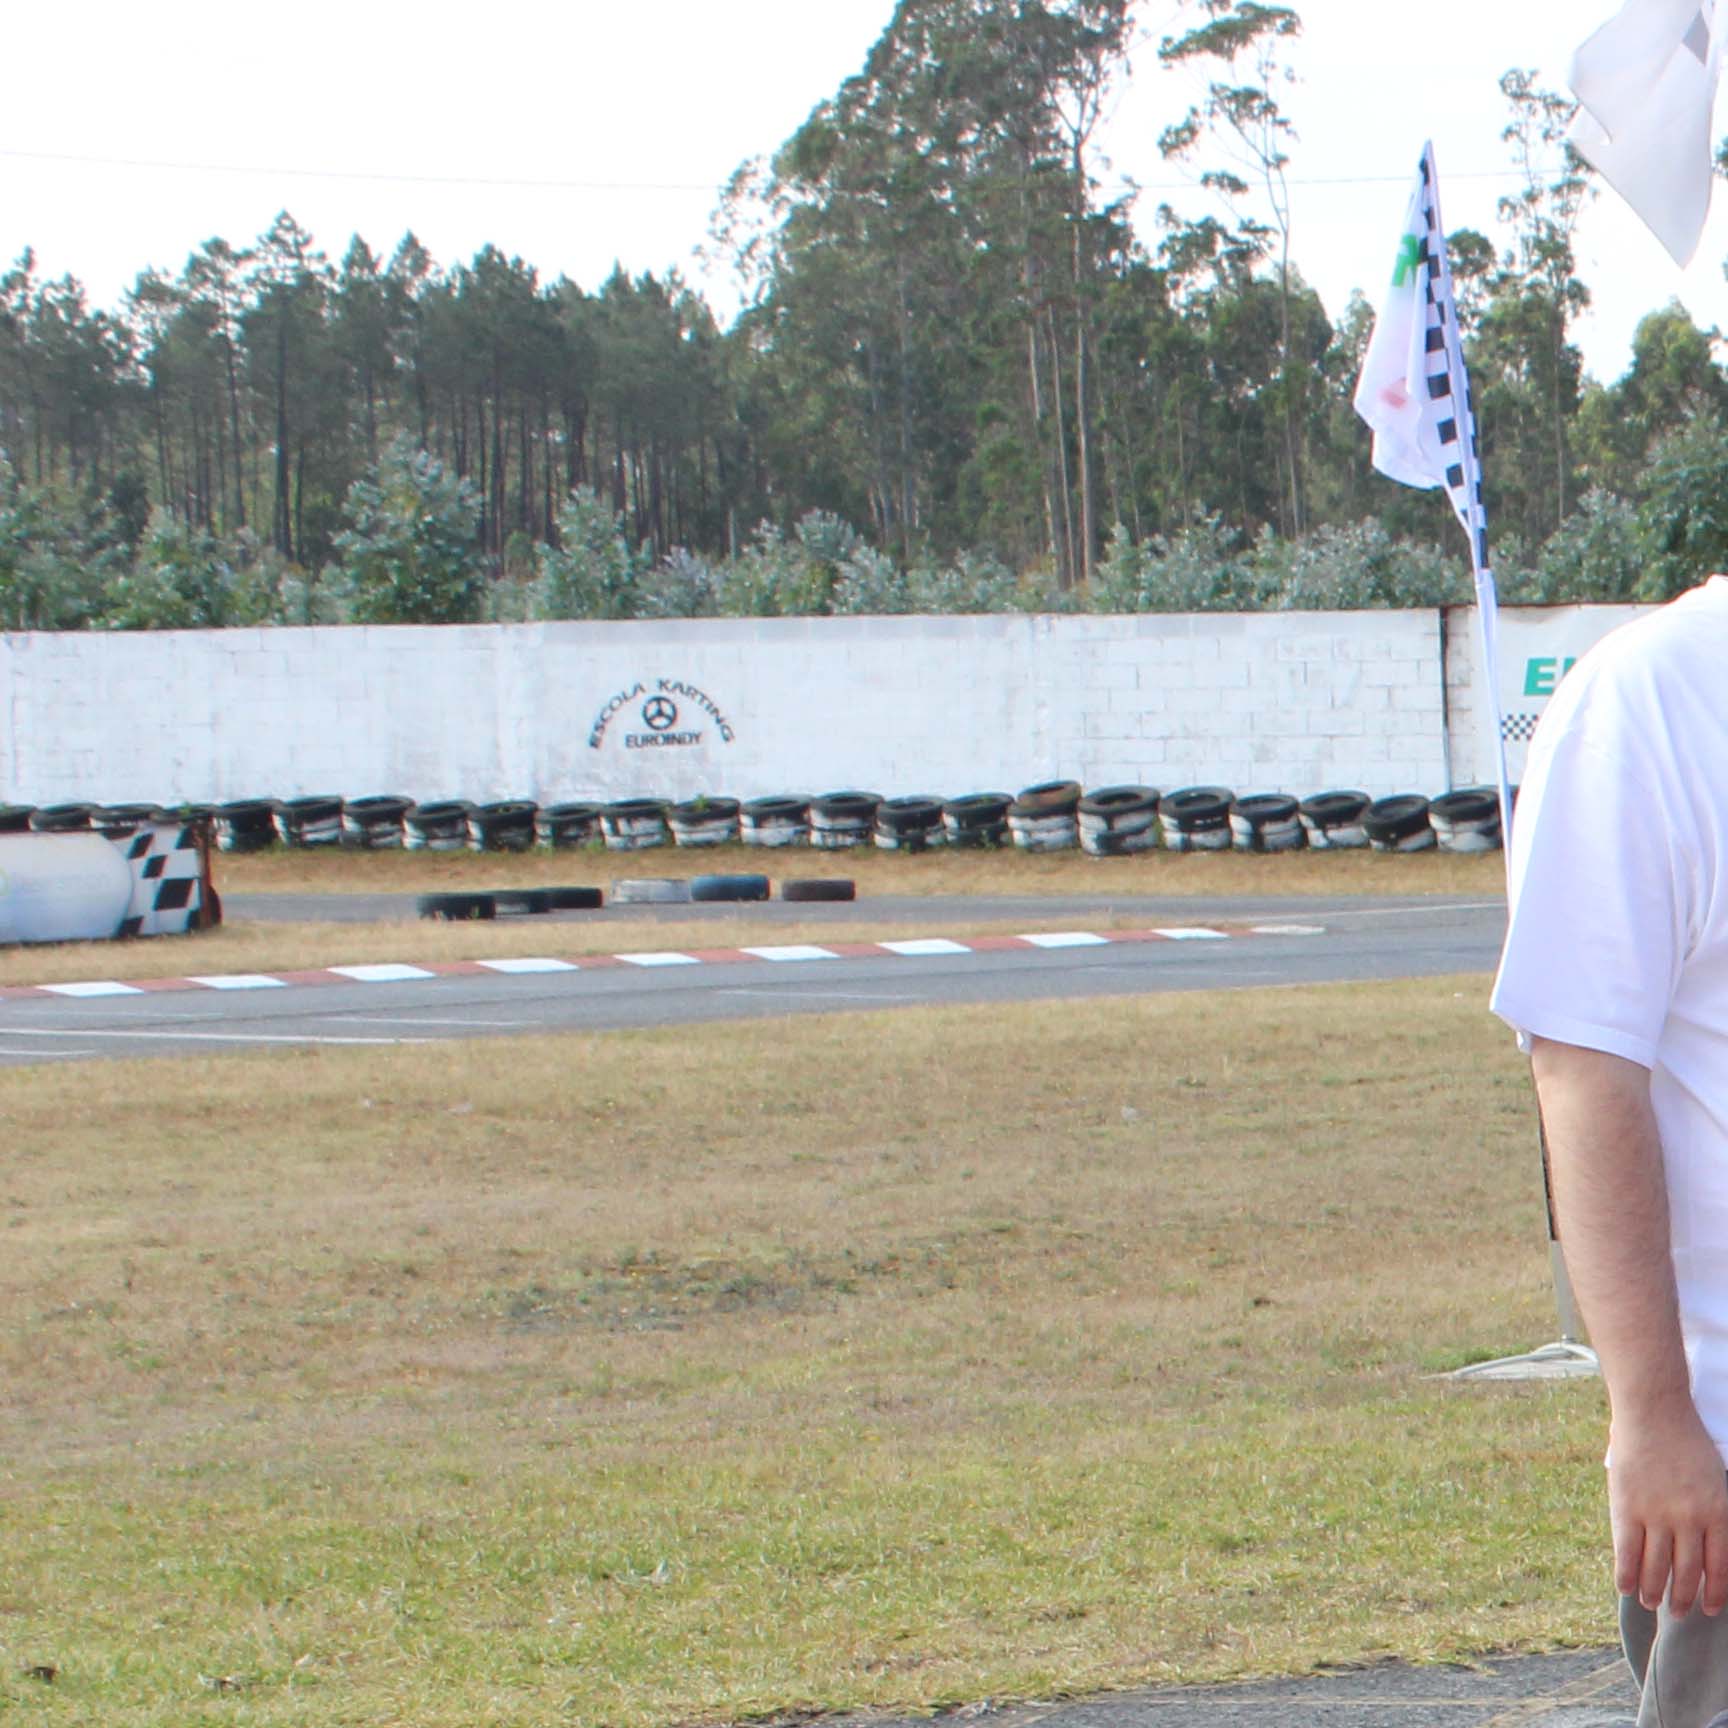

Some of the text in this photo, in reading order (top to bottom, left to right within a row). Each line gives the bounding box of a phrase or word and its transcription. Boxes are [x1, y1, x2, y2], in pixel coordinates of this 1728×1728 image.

[588, 678, 735, 750] ESCOLA KARTING
[625, 732, 701, 749] EUROINDY
